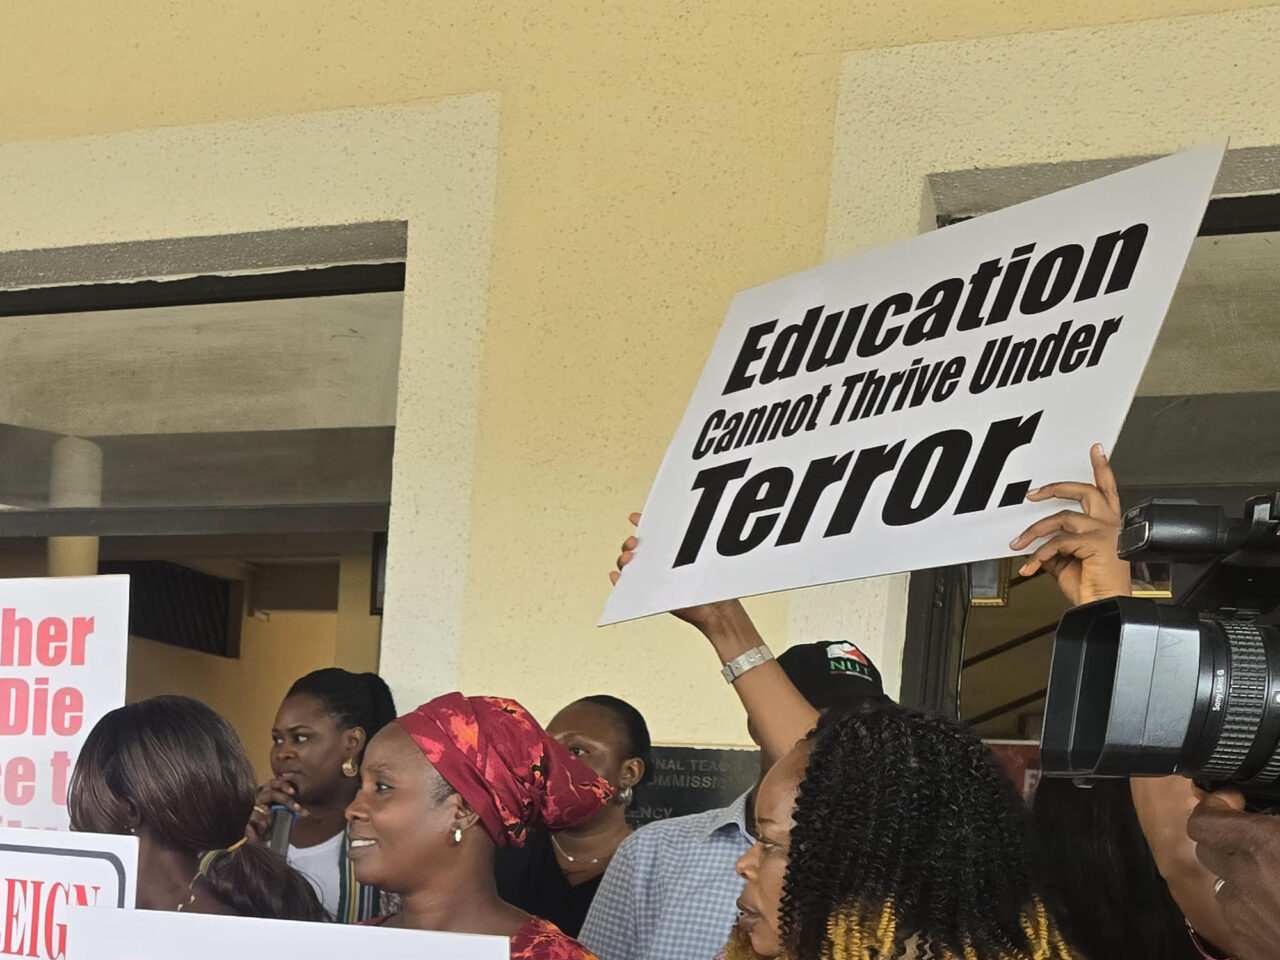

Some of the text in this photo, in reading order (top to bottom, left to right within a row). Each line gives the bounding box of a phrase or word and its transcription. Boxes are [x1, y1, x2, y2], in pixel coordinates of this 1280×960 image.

[722, 223, 1149, 396] Education
[692, 315, 1124, 460] Cannot Thrive Under
[672, 410, 1044, 569] Terror.
[1212, 693, 1224, 711] Sony
[50, 751, 71, 806] t
